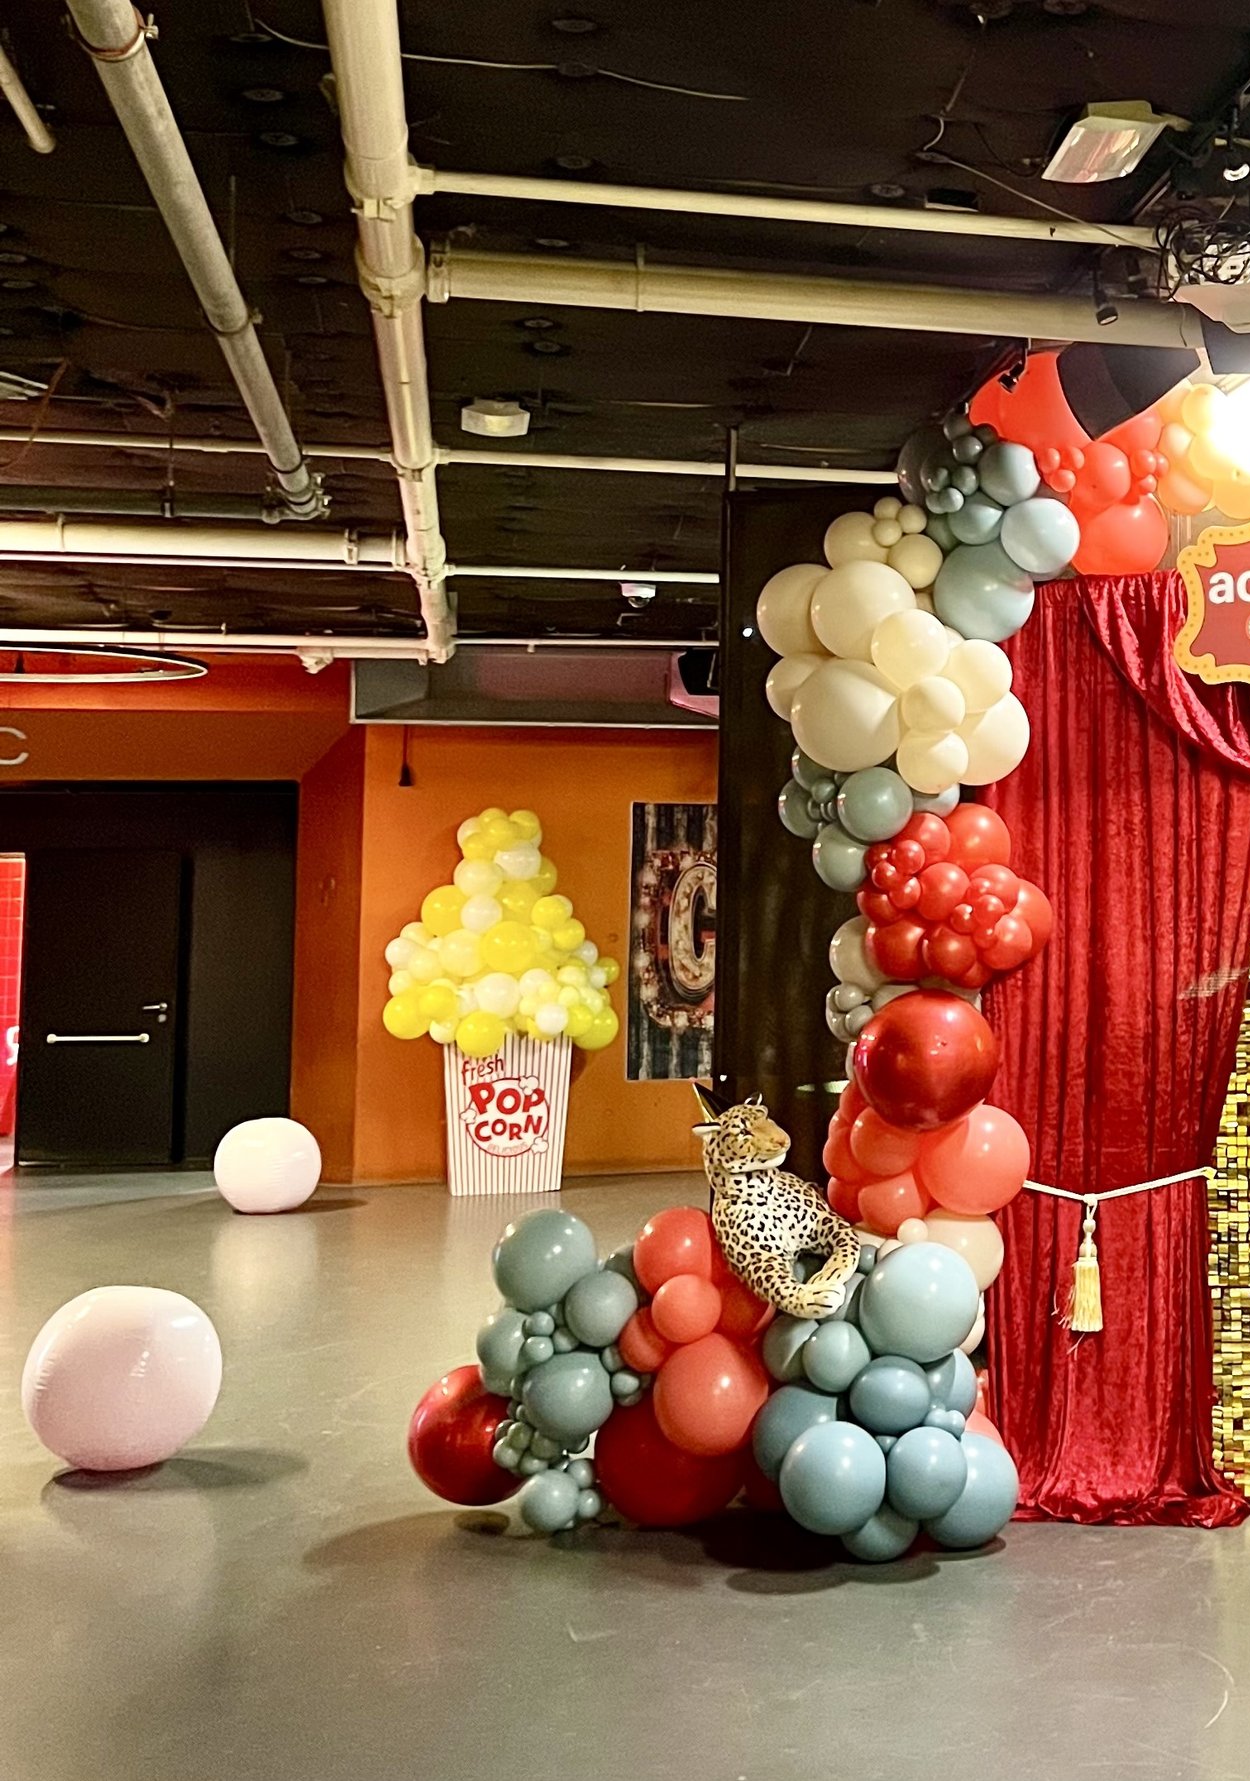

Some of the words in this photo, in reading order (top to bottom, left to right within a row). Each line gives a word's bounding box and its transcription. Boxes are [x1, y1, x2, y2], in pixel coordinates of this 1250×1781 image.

[461, 1051, 505, 1086] fresh
[468, 1082, 546, 1115] POP
[474, 1114, 543, 1142] CORN
